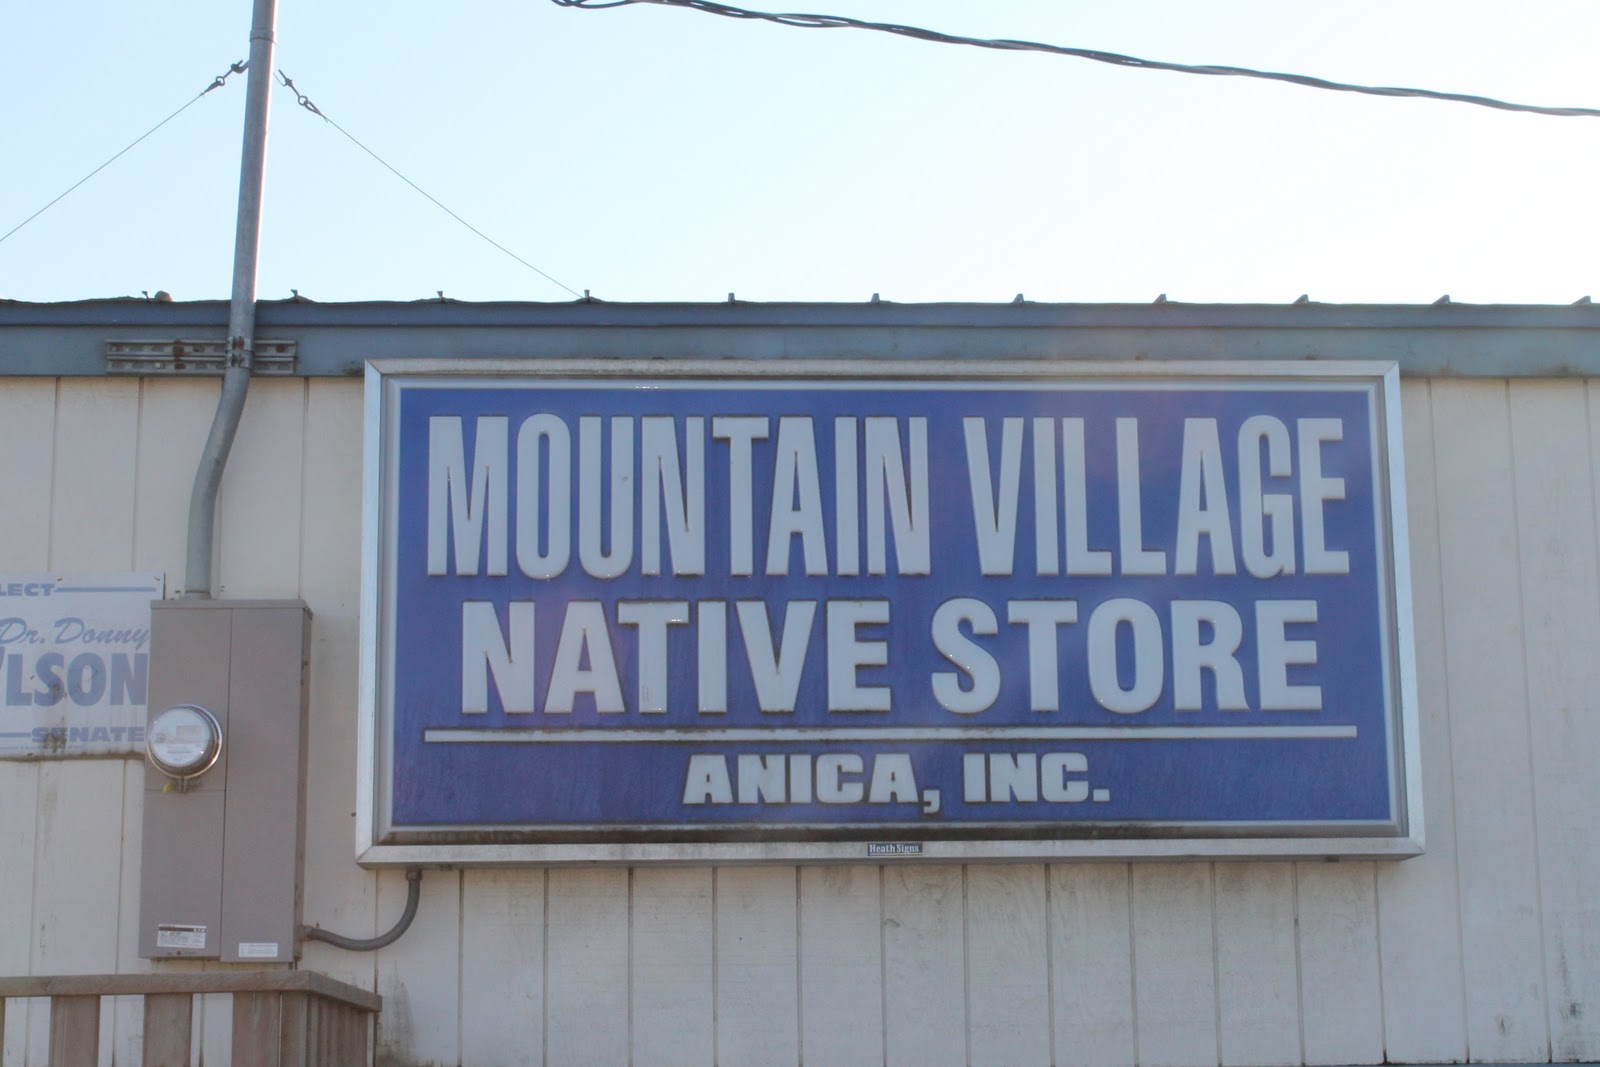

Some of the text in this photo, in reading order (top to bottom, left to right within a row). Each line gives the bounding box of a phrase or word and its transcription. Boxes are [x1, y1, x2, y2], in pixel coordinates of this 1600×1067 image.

[427, 413, 1350, 579] MOUNTAIN VILLAGE
[0, 617, 150, 651] Dr. Donny
[461, 598, 1323, 714] NATIVE STORE
[31, 727, 145, 743] SENATE
[682, 753, 1110, 814] ANICA, INC.
[869, 844, 919, 854] Heath Signs
